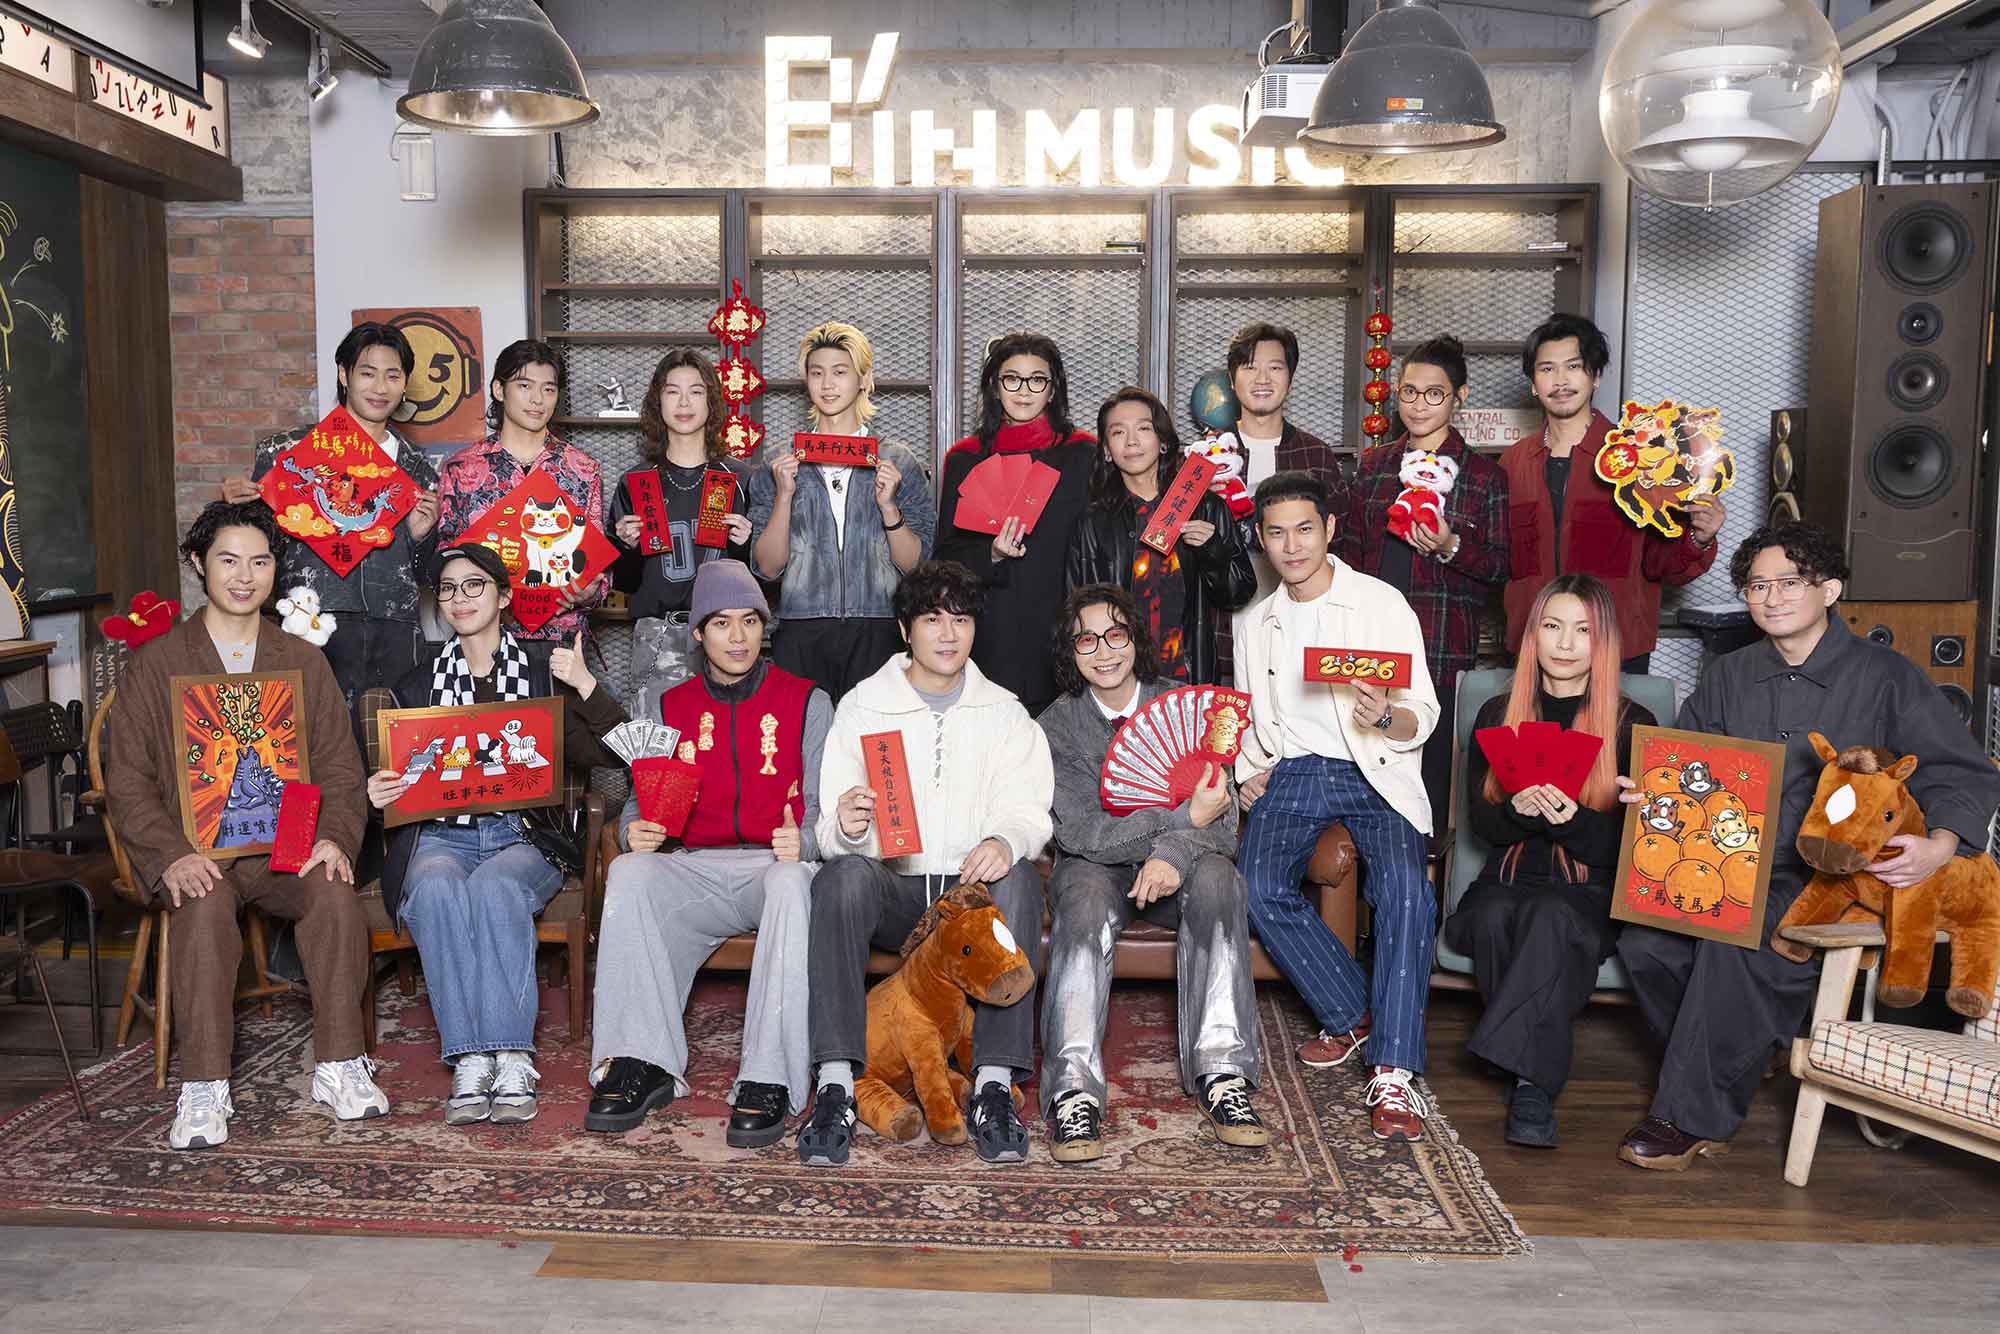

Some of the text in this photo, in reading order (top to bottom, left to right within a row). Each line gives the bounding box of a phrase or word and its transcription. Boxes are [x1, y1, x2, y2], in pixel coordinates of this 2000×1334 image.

[1451, 411, 1506, 426] CENTRAL
[330, 541, 353, 563] 福
[519, 589, 551, 603] Good
[1318, 654, 1398, 681] 2026
[442, 783, 504, 801] 旺事平安
[1655, 889, 1722, 917] 馬吉馬吉
